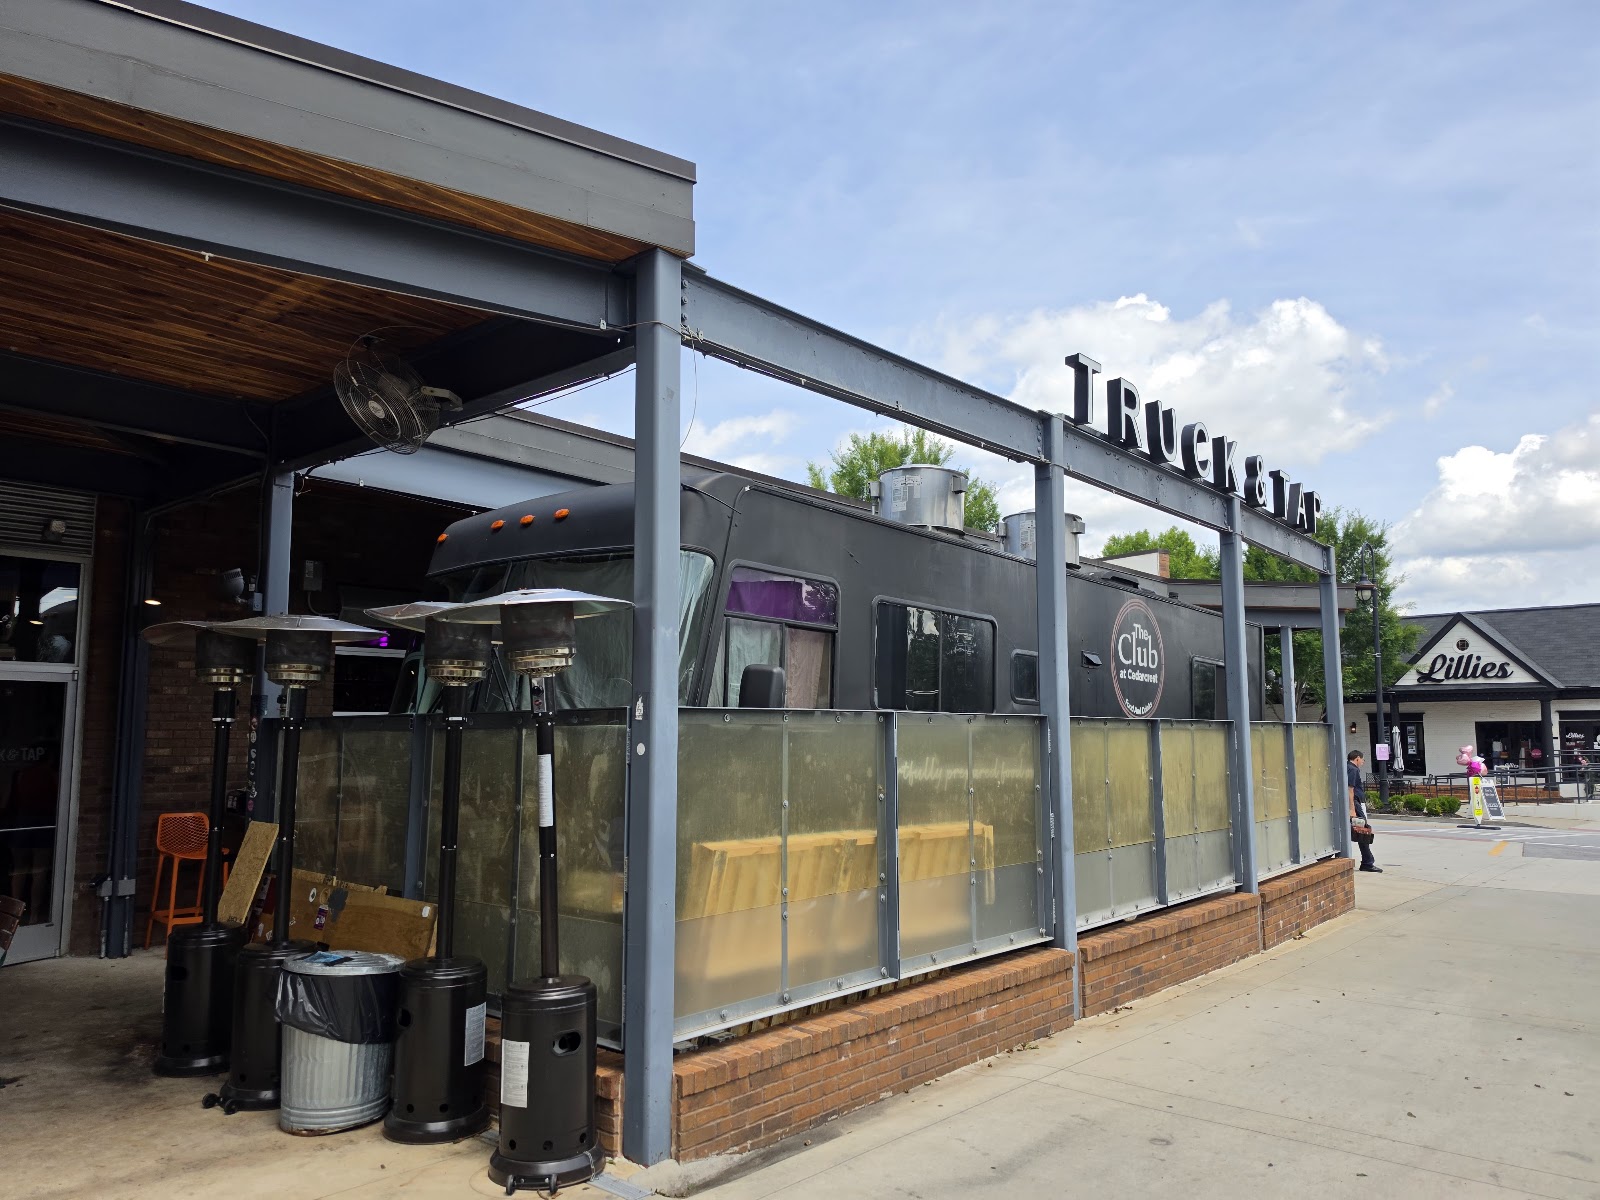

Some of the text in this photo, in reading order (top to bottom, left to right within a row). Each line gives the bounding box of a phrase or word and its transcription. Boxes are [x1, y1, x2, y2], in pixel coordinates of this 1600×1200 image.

[1065, 353, 1321, 533] TRUCK & TAP
[1133, 623, 1149, 641] The
[1118, 632, 1158, 668] Club
[1119, 668, 1158, 684] at Cedarcrest
[1416, 653, 1513, 683] Lillies
[20, 747, 46, 761] TAP
